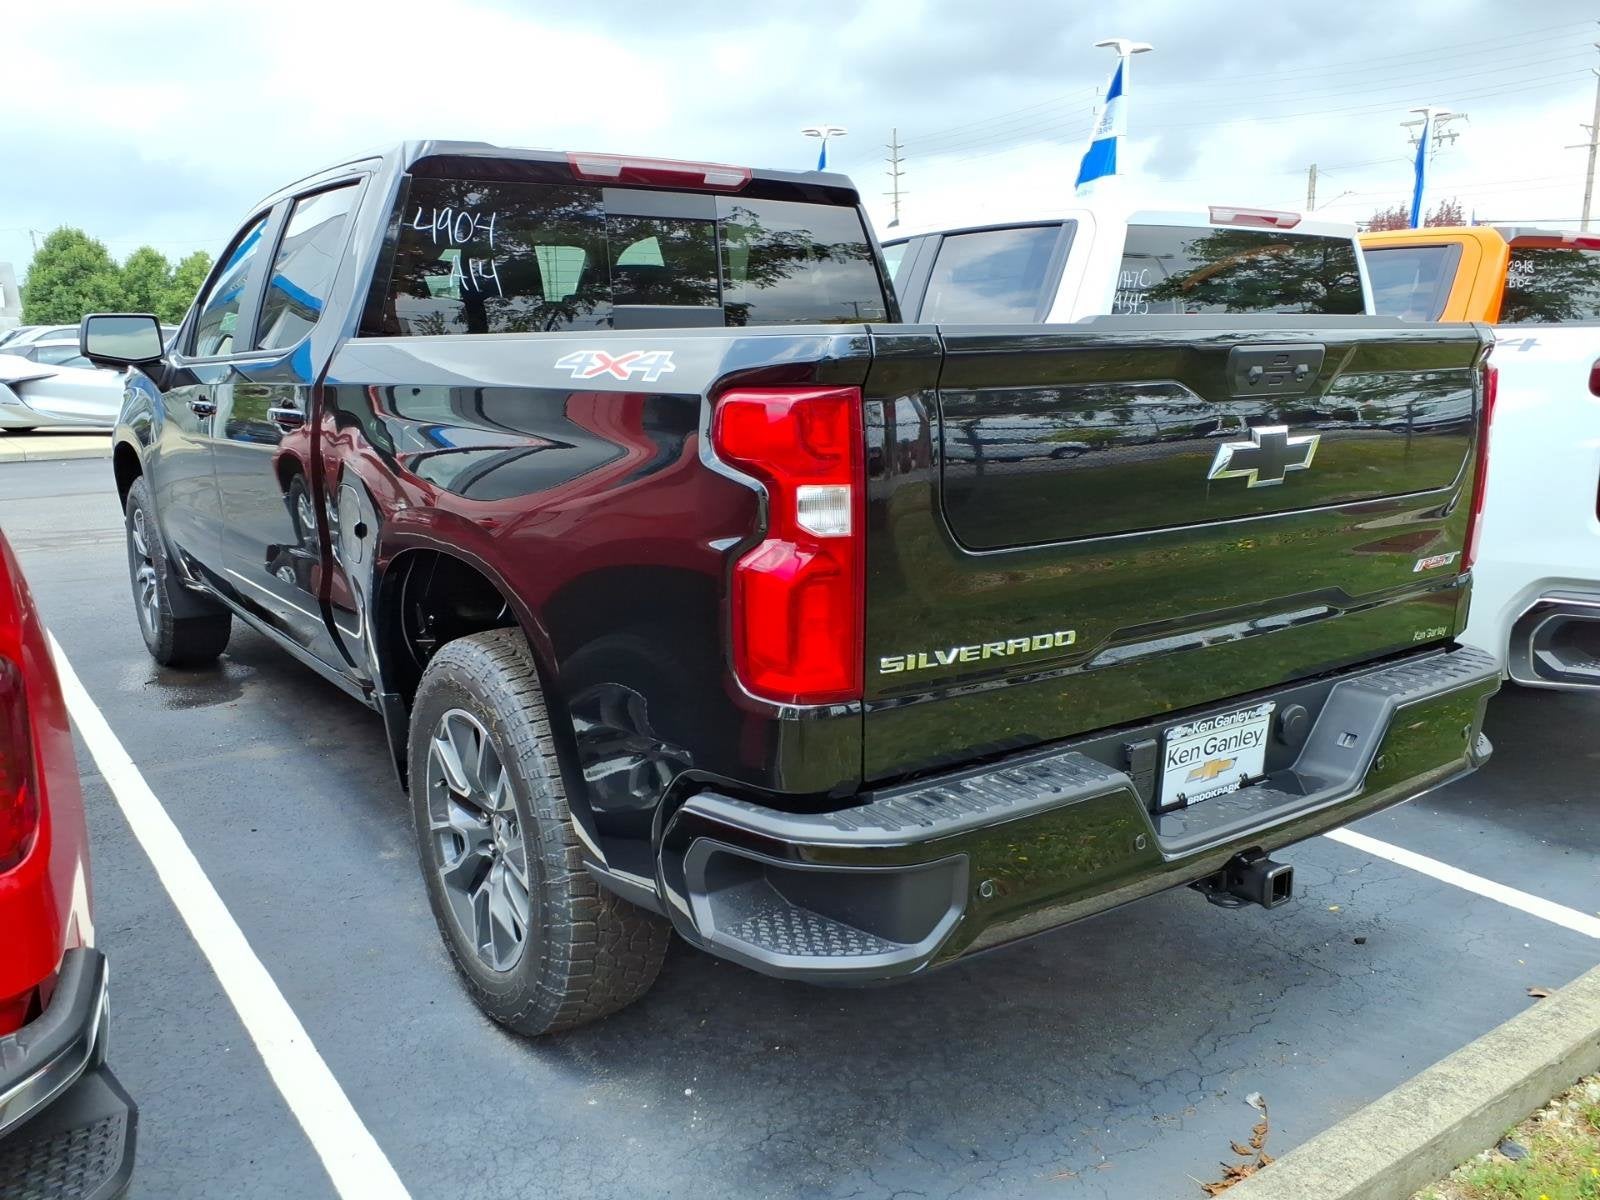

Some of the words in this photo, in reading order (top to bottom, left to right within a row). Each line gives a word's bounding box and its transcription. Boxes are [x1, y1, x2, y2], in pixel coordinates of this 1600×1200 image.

[413, 206, 496, 248] 4904
[879, 630, 1076, 674] SILVERADO
[1191, 720, 1214, 735] Ken
[1214, 710, 1251, 727] Ganley
[1166, 745, 1200, 769] Ken
[1203, 728, 1264, 756] Ganley
[1187, 782, 1240, 805] BROOKPARK
